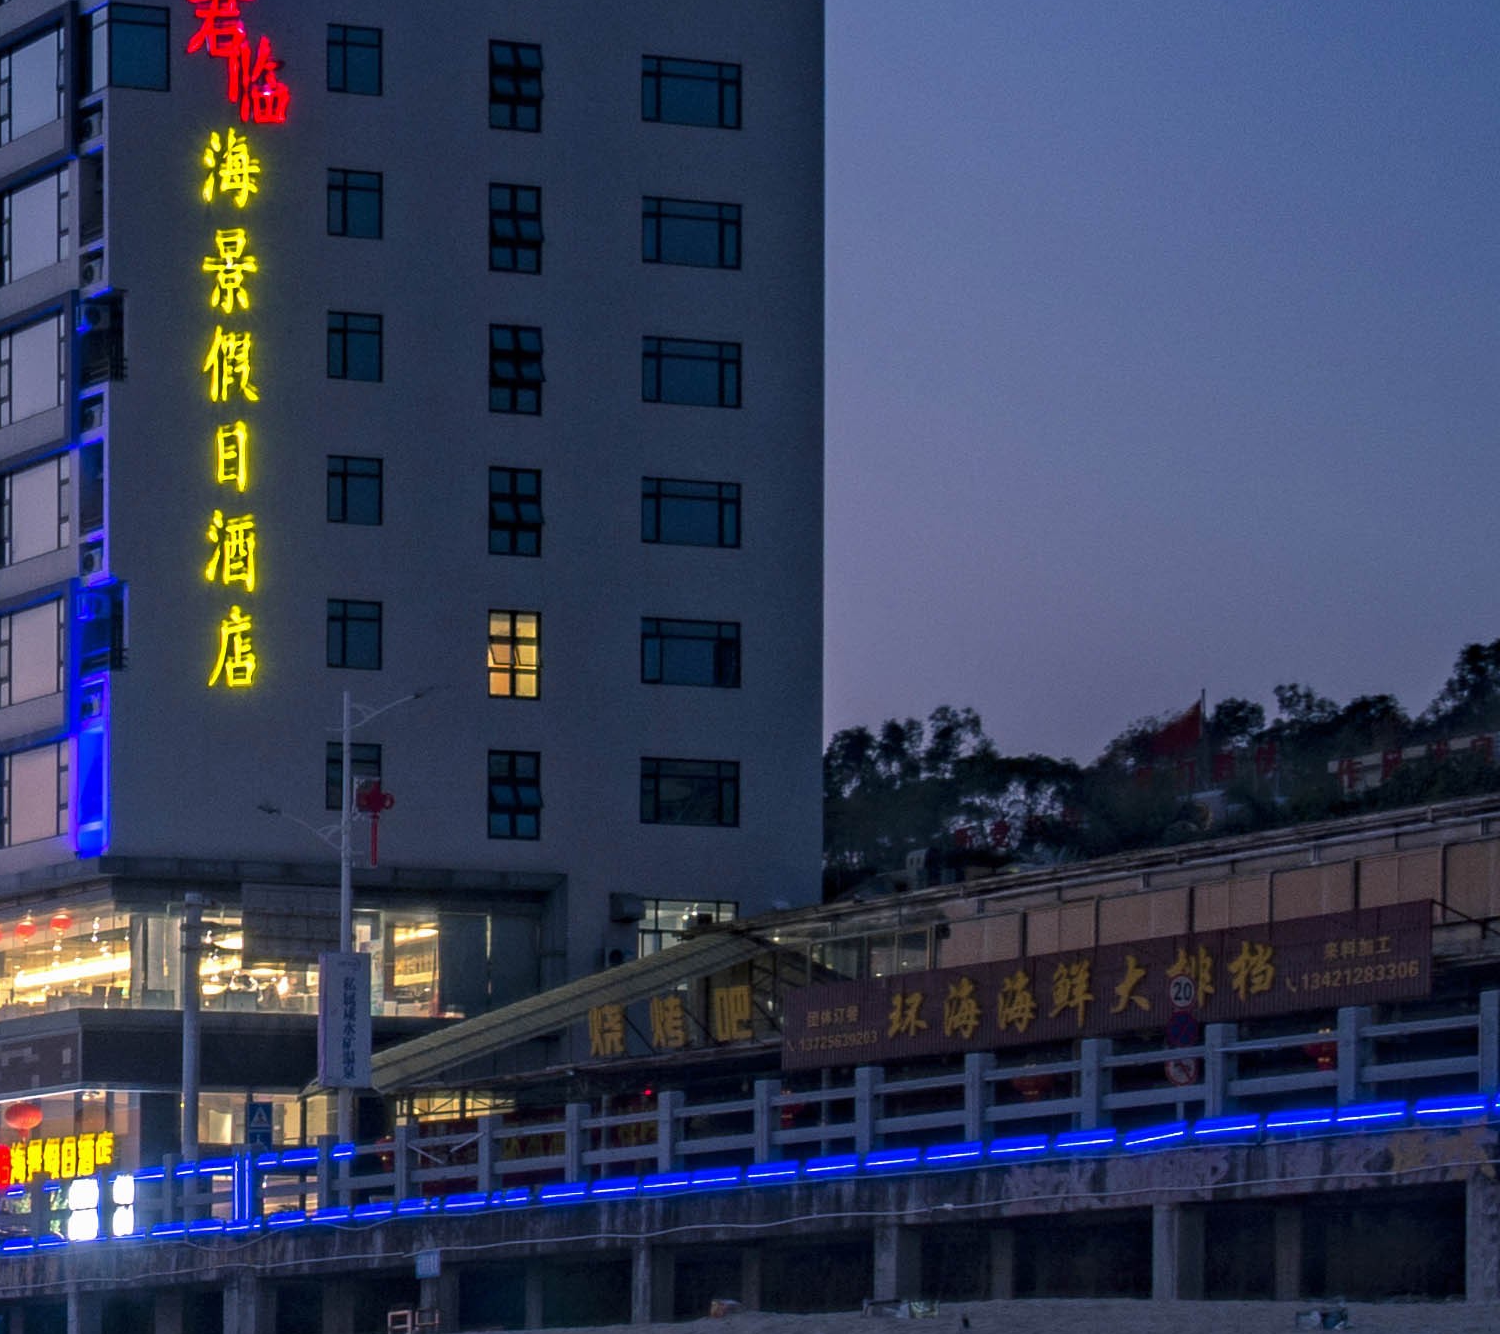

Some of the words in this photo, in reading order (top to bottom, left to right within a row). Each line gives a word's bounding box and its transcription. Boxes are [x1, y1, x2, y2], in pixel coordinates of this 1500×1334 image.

[1302, 959, 1420, 991] 13421283306
[1173, 981, 1193, 1002] 20
[589, 985, 755, 1057] 烧烤吧
